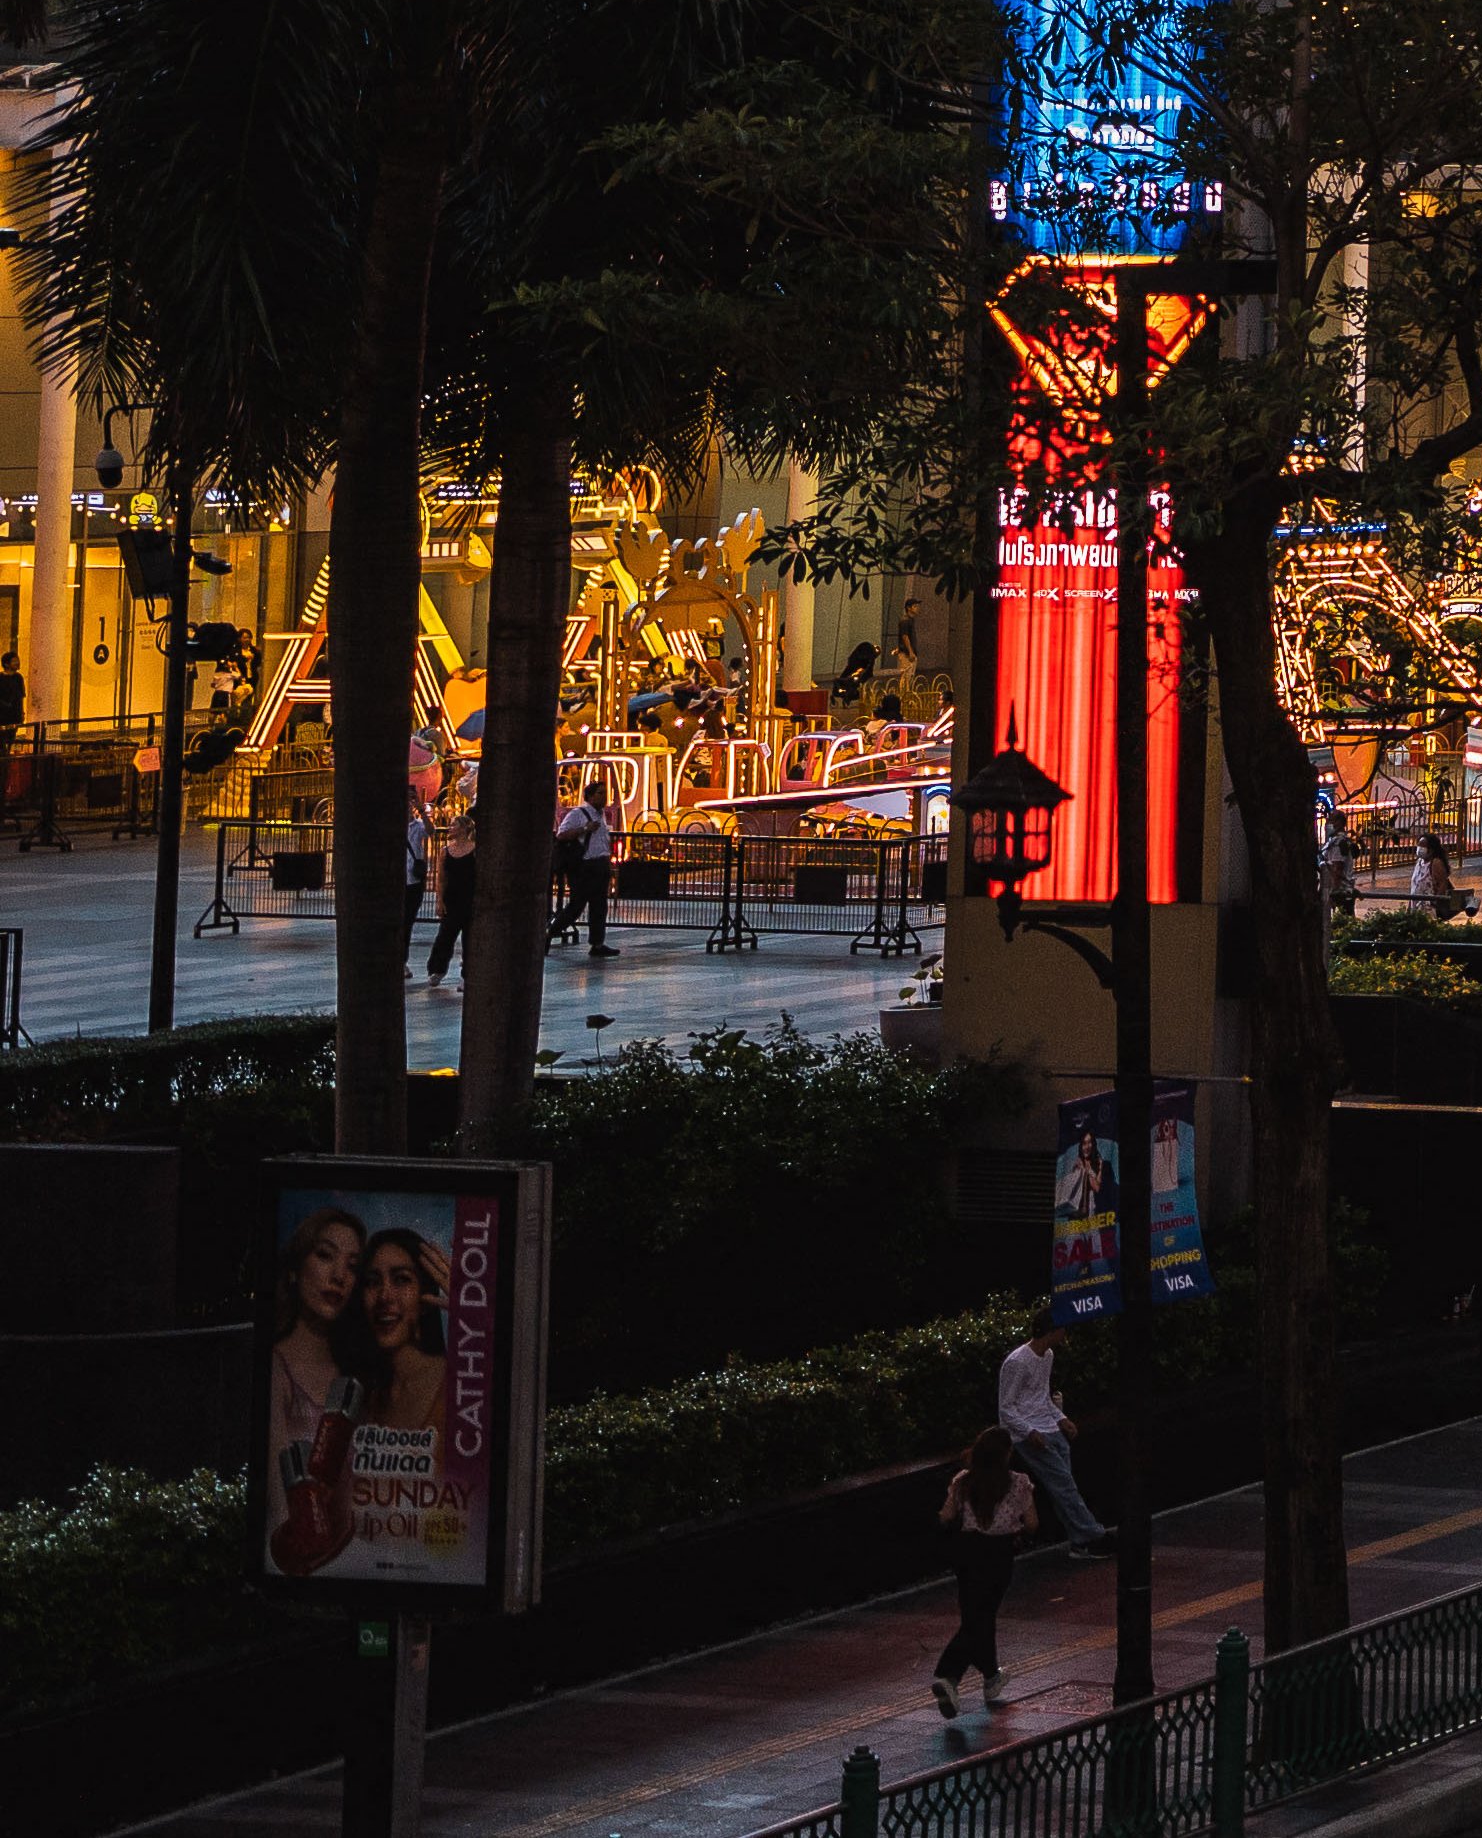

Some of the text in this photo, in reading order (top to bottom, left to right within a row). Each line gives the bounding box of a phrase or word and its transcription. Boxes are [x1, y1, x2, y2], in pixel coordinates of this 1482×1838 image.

[1164, 1273, 1195, 1293] VISA
[1072, 1295, 1103, 1315] VISA
[455, 1213, 492, 1457] CATHY DOLL
[354, 1447, 431, 1474] กันแดด
[353, 1478, 472, 1512] SUNDAY
[386, 1511, 419, 1540] Oil
